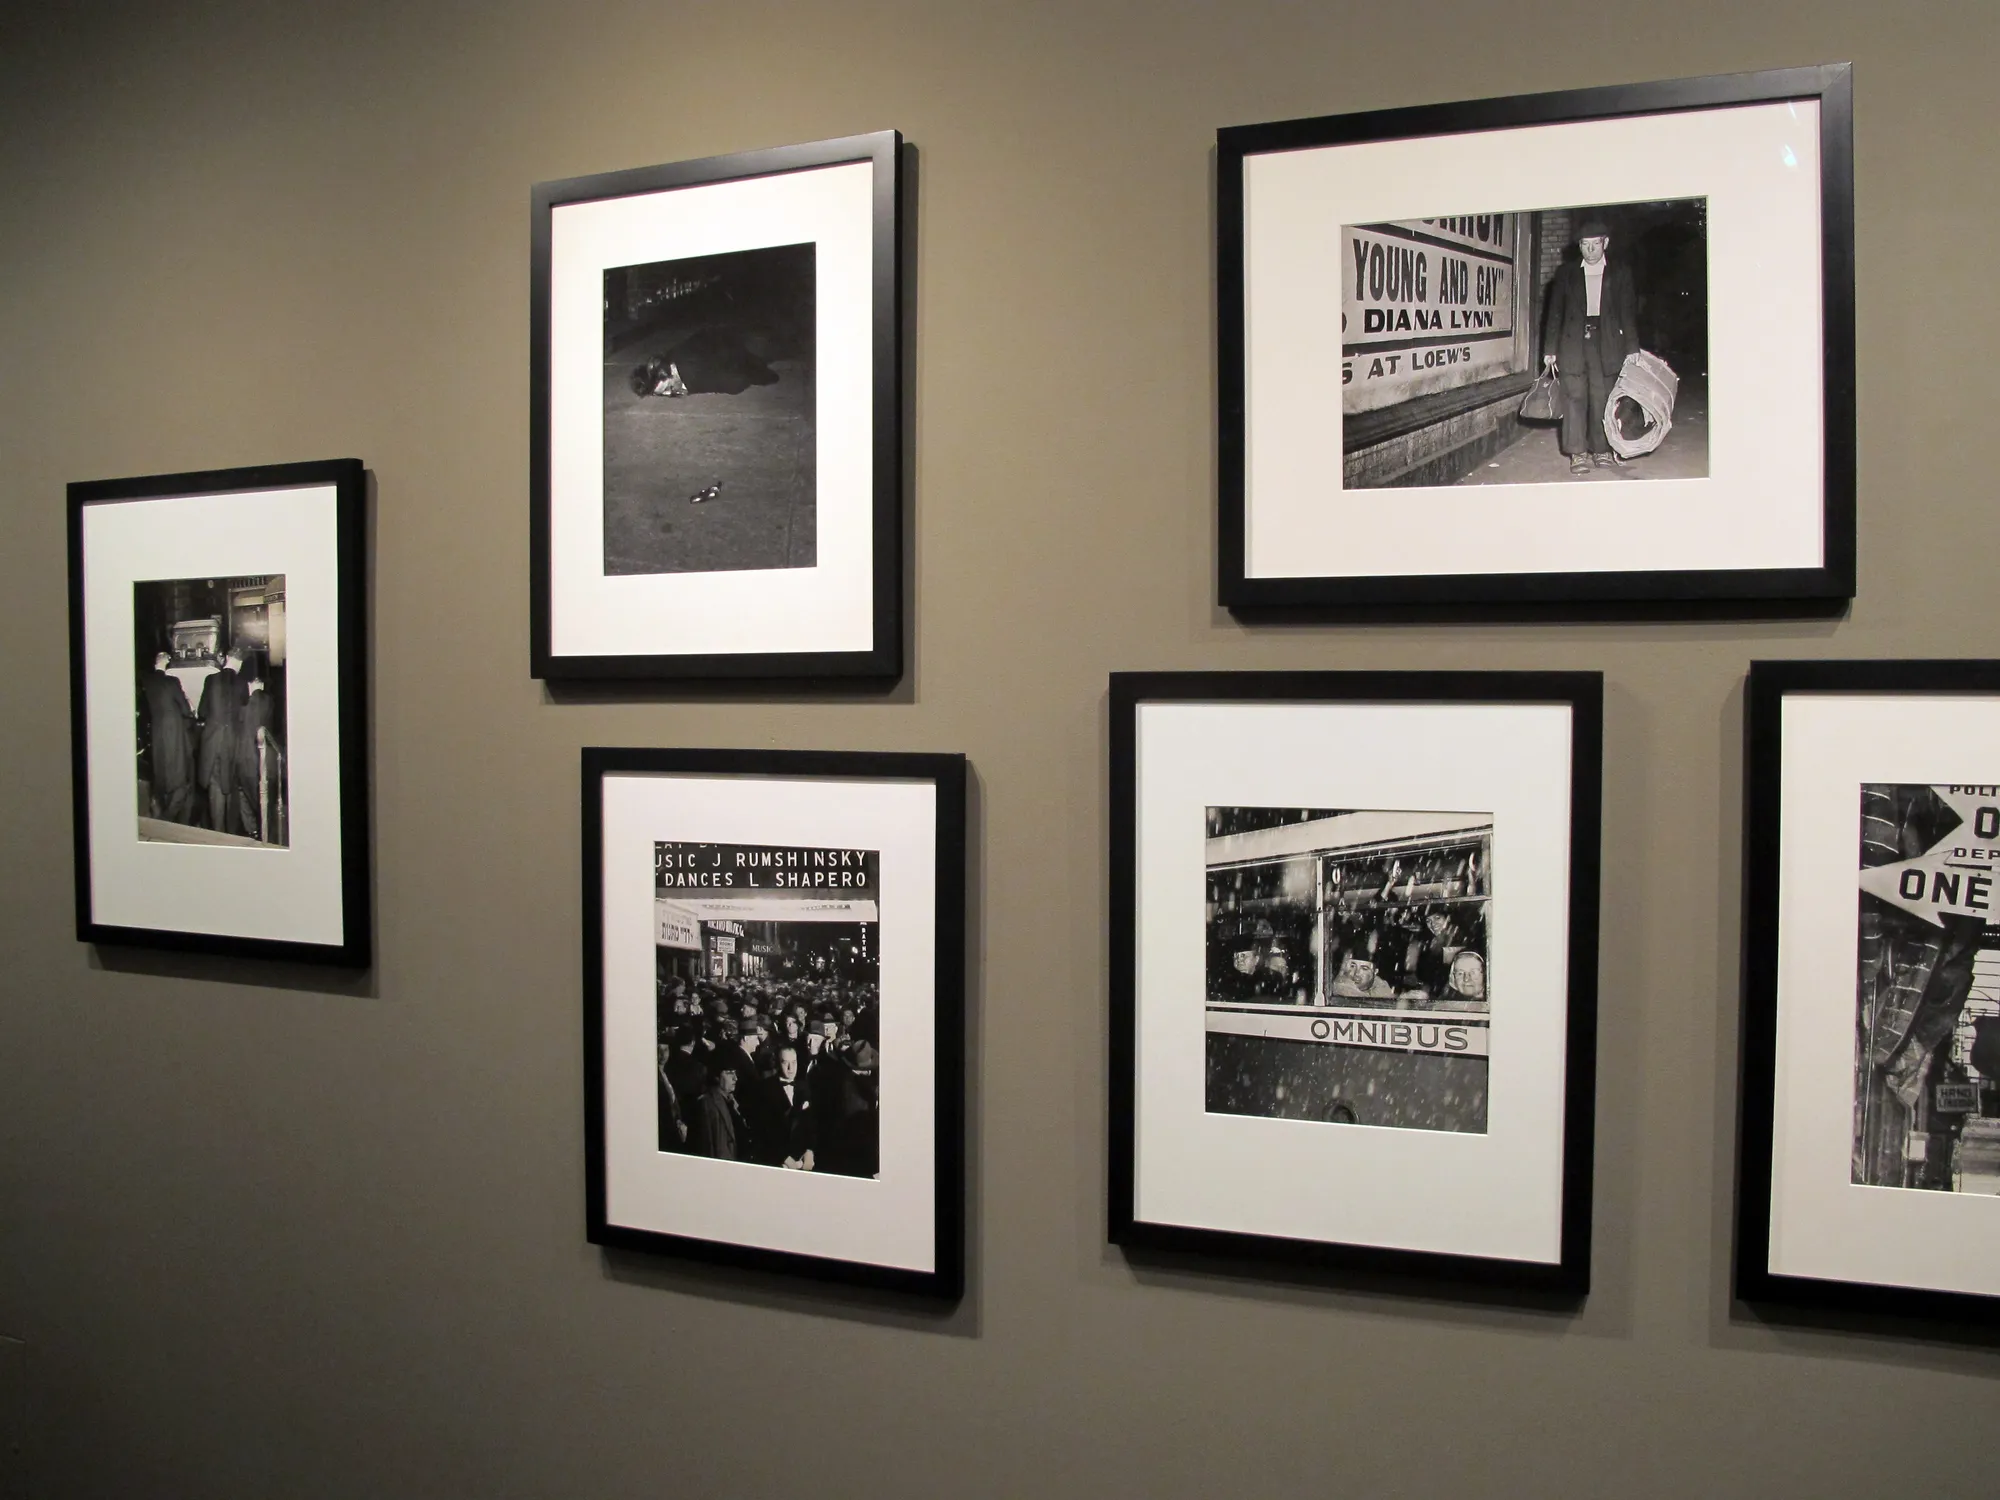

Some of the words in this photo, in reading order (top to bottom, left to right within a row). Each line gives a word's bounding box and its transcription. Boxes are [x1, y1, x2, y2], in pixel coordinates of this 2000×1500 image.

[1352, 238, 1428, 304] YOUNG
[1439, 256, 1469, 306] AND
[1363, 308, 1443, 334] DIANA
[1450, 310, 1494, 330] LYNN
[1367, 355, 1401, 380] AT
[1412, 346, 1471, 371] LOEW'S
[712, 852, 721, 867] J
[735, 850, 866, 868] RUMSHINSKY
[1953, 847, 2000, 860] DEP
[665, 872, 734, 887] DANCES
[749, 872, 760, 887] L
[775, 872, 867, 887] SHAPERO
[1899, 868, 1993, 910] ONE
[1310, 1018, 1469, 1051] OMNIBUS
